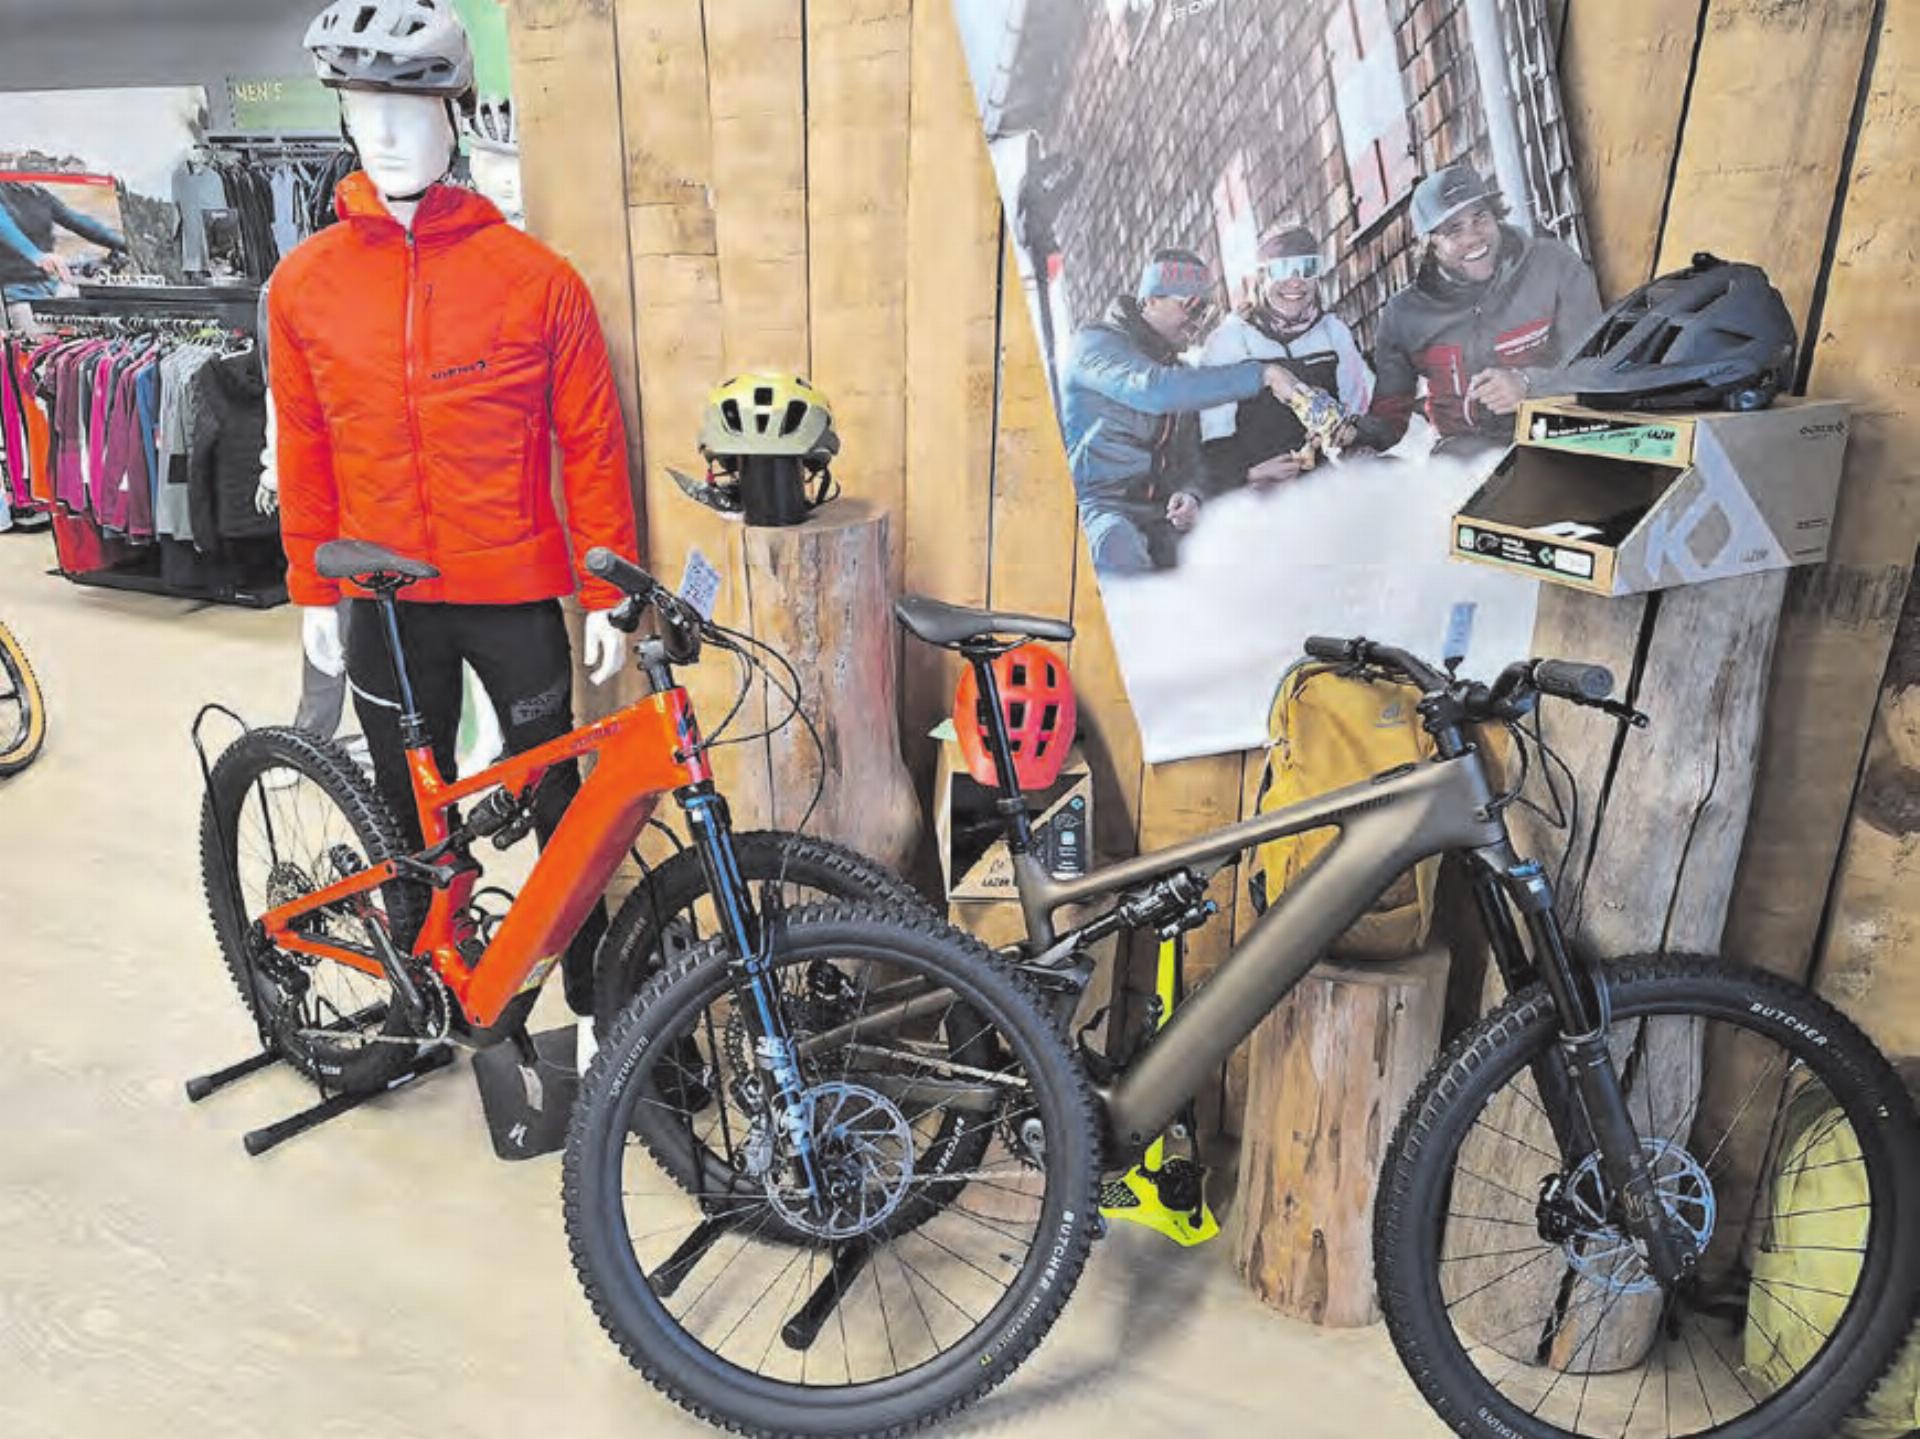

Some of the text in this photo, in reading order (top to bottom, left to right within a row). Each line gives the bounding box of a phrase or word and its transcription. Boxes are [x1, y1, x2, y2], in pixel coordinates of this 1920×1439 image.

[234, 82, 283, 101] MEN'S
[1749, 1002, 1828, 1046] BUTCHER
[1039, 1210, 1075, 1290] BUTCHER
